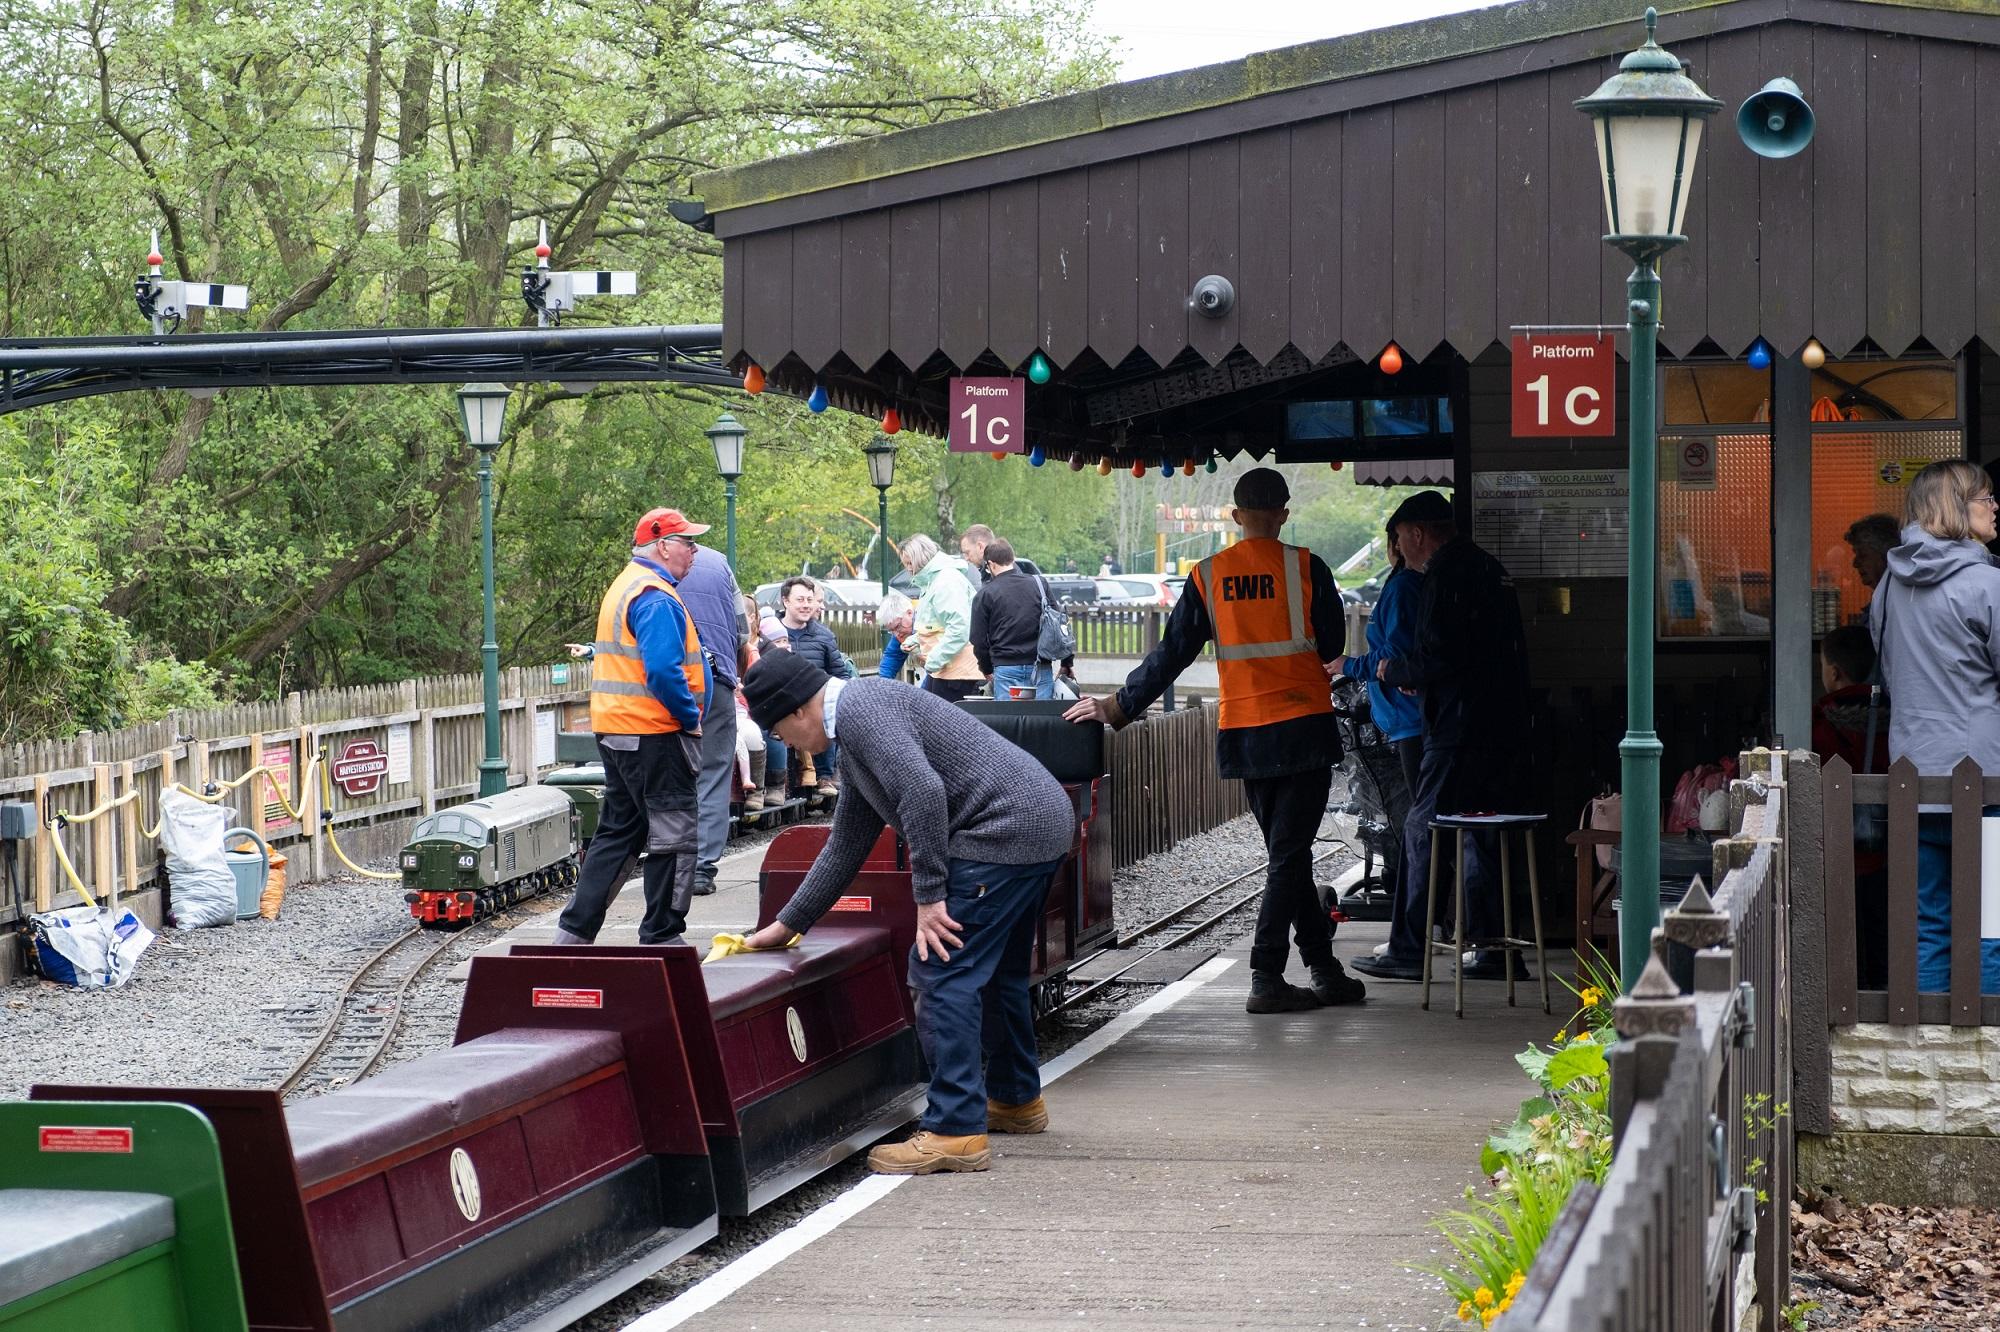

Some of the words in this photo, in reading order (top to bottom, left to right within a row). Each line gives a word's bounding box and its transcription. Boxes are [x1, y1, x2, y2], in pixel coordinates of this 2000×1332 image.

[1533, 345, 1594, 358] Platform
[965, 385, 1009, 396] Platform
[1539, 474, 1570, 483] WOOD
[1572, 473, 1615, 482] RAILWAY
[1547, 488, 1602, 497] OPERATING
[1165, 504, 1197, 520] Lake
[1222, 574, 1275, 601] EWR
[458, 856, 474, 866] 40
